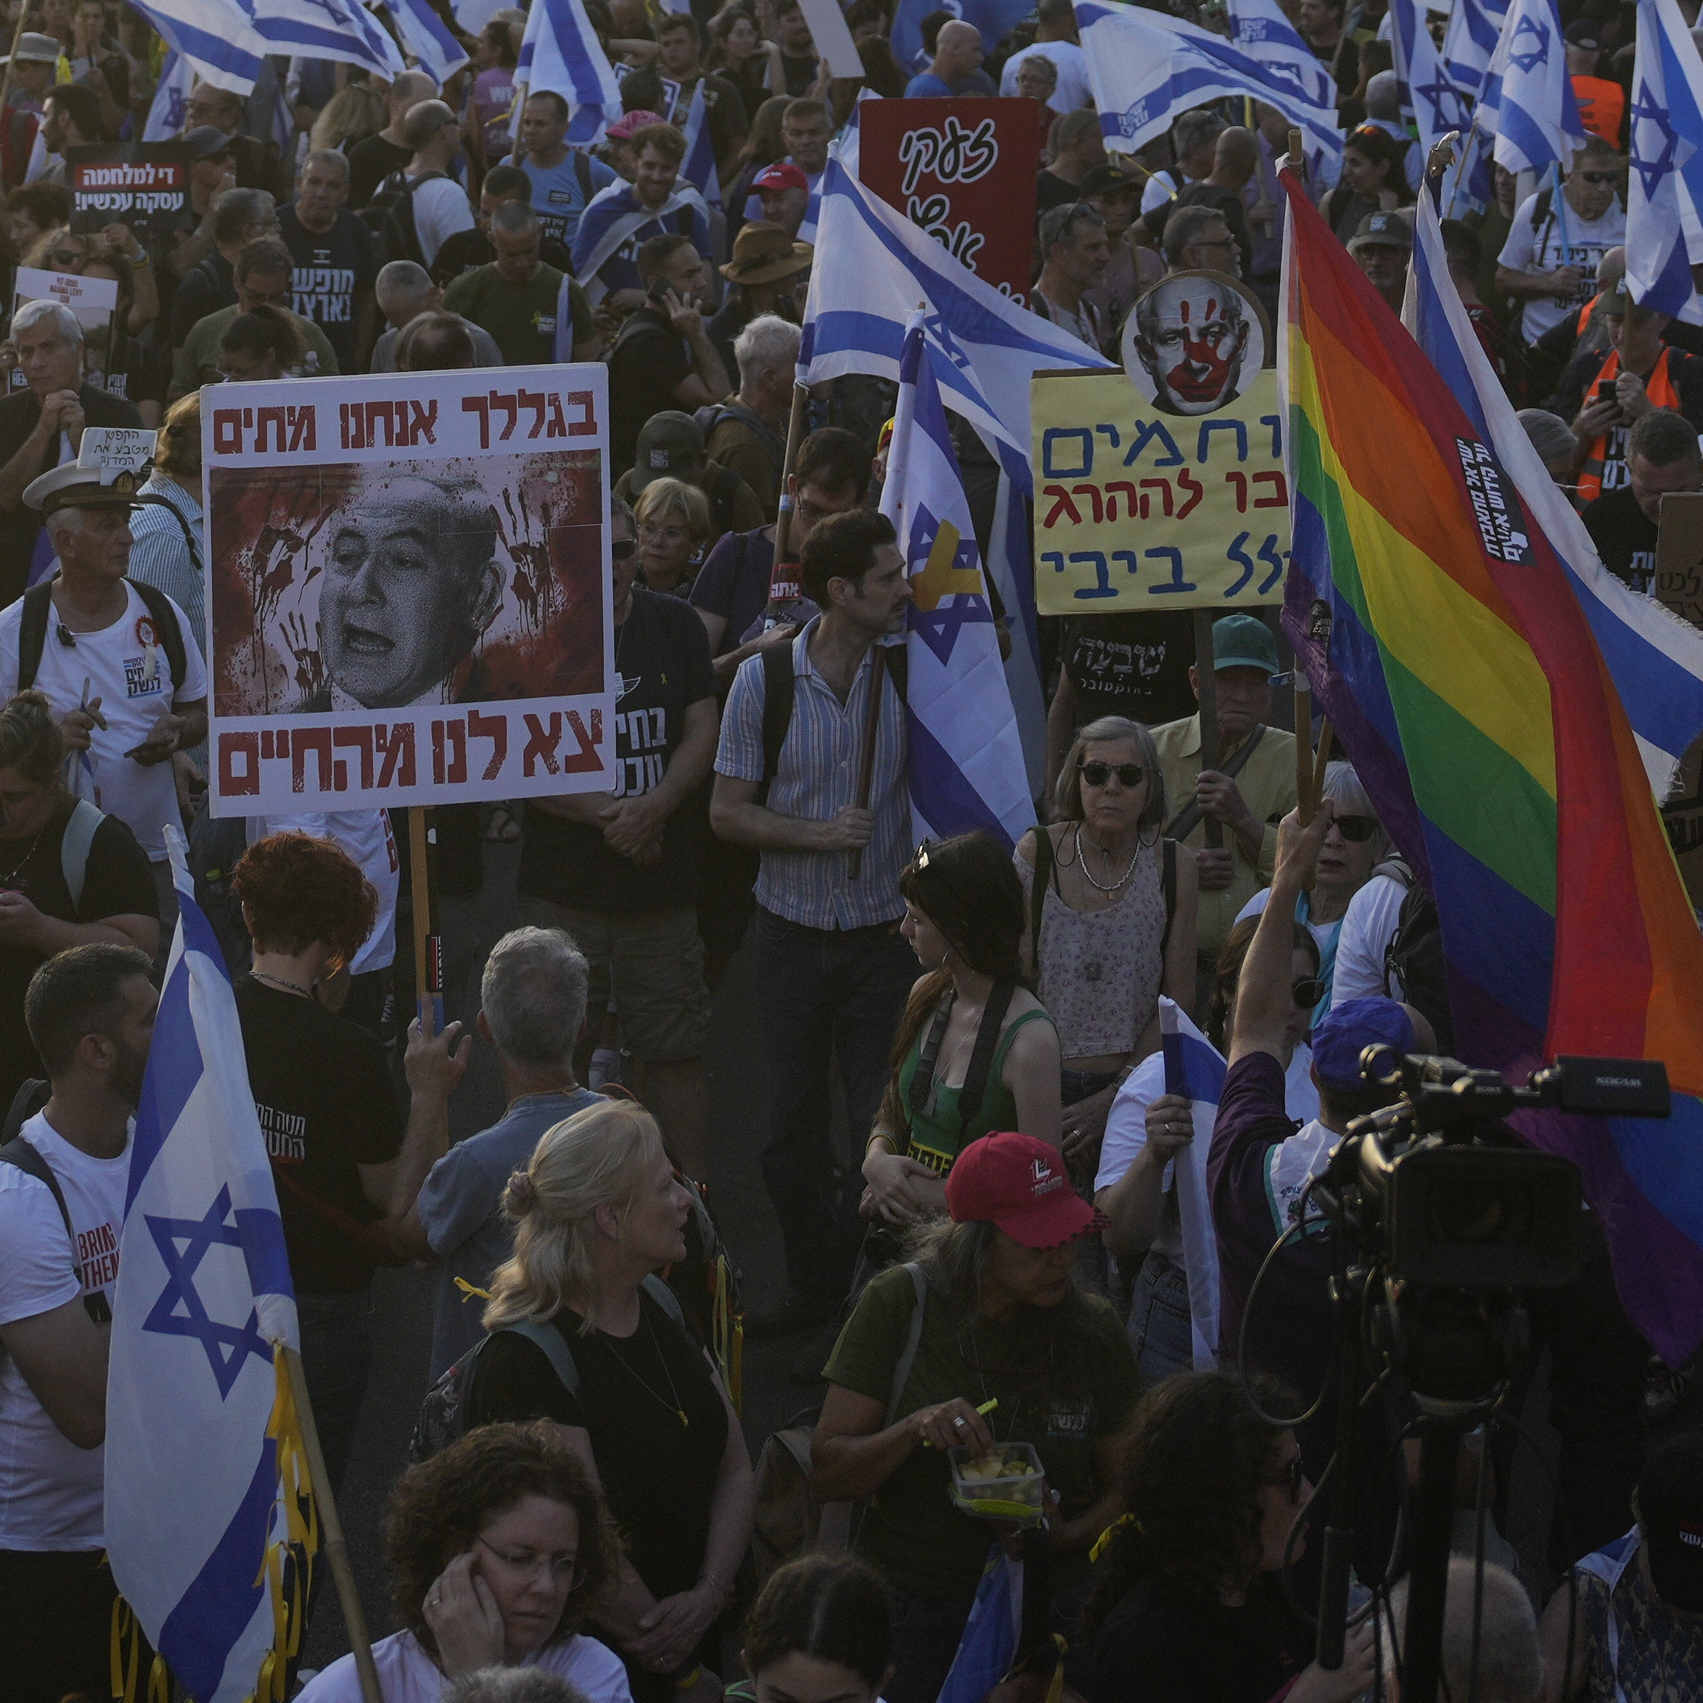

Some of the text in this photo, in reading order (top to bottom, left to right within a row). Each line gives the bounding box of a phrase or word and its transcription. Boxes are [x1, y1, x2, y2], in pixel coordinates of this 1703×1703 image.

[83, 163, 175, 185] די למלחמה
[74, 192, 185, 215] עסקה עכשיו!
[214, 388, 598, 454] בגללך אנחנו מתים
[1042, 414, 1282, 479] וחמים
[1456, 439, 1501, 558] ישראל מתאבדת
[1473, 442, 1506, 510] על קידוש
[1041, 546, 1199, 600] ביבי
[218, 709, 604, 797] צא לנו מהחיים
[615, 706, 667, 751] בחי
[1475, 1086, 1502, 1095] SONY
[277, 1110, 307, 1137] מטה
